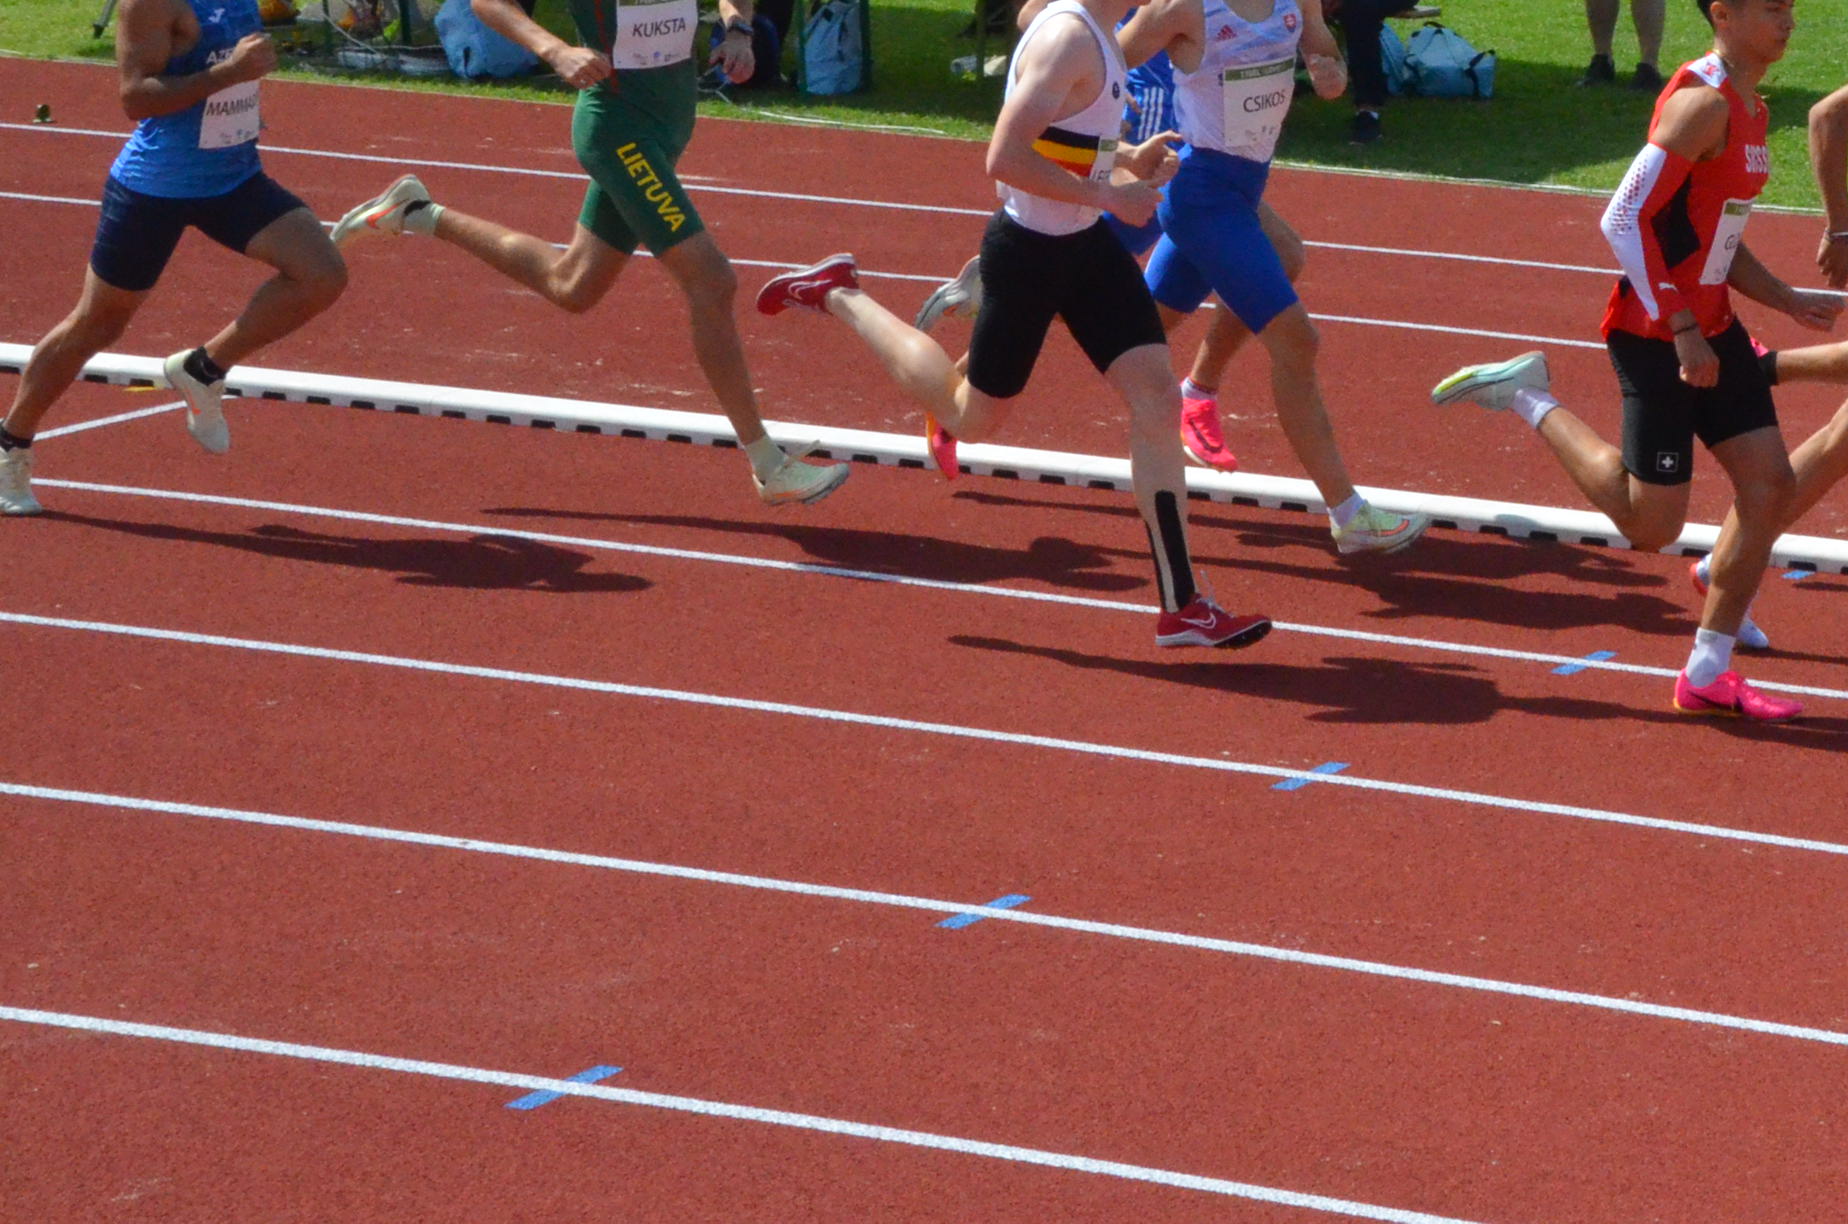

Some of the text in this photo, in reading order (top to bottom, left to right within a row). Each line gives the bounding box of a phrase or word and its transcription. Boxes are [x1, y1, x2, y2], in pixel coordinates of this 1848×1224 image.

[632, 17, 687, 38] KUKSTA
[1242, 89, 1286, 113] CSIKOS
[616, 141, 686, 232] LIETUVA
